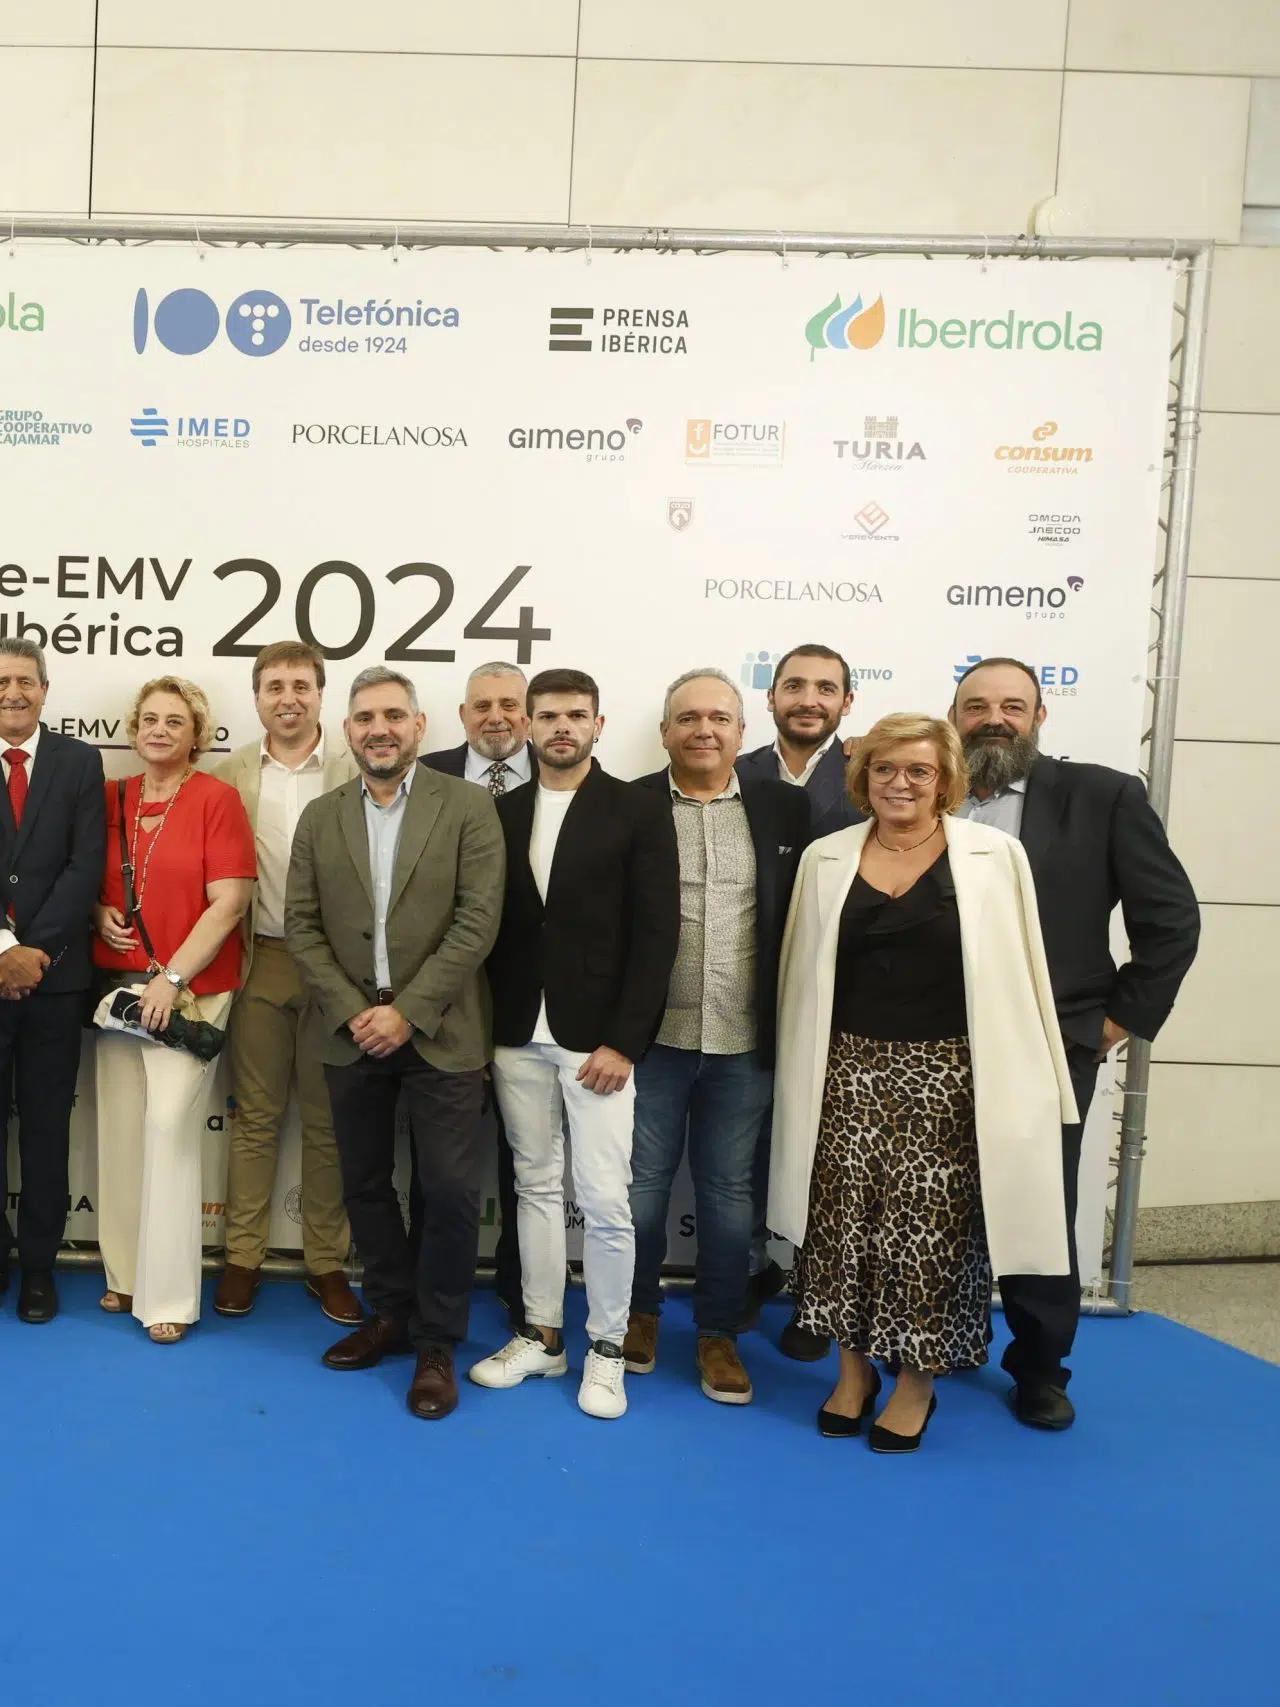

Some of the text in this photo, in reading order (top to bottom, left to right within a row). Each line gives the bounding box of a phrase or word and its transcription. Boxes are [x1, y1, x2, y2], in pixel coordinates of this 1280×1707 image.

[299, 298, 460, 328] Telefónica
[603, 308, 689, 328] PRENSA
[897, 308, 1103, 351] Iberdrola
[299, 336, 407, 353] desde 1924
[601, 331, 688, 354] IBÉRICA
[177, 417, 251, 438] IMED
[291, 423, 468, 447] PORCELANOSA
[713, 423, 780, 442] FOTUR
[177, 438, 250, 449] HOSPITALES
[832, 440, 927, 460] TURIA
[586, 453, 625, 463] grupo
[993, 445, 1094, 463] consum
[1007, 465, 1079, 475] COOPERATIVA
[704, 578, 884, 603] PORCELANOSA
[210, 557, 552, 665] 2024
[1025, 610, 1066, 620] grupo
[0, 611, 184, 658] Ibérica
[1040, 666, 1079, 686] ED
[1040, 687, 1078, 697] TALES
